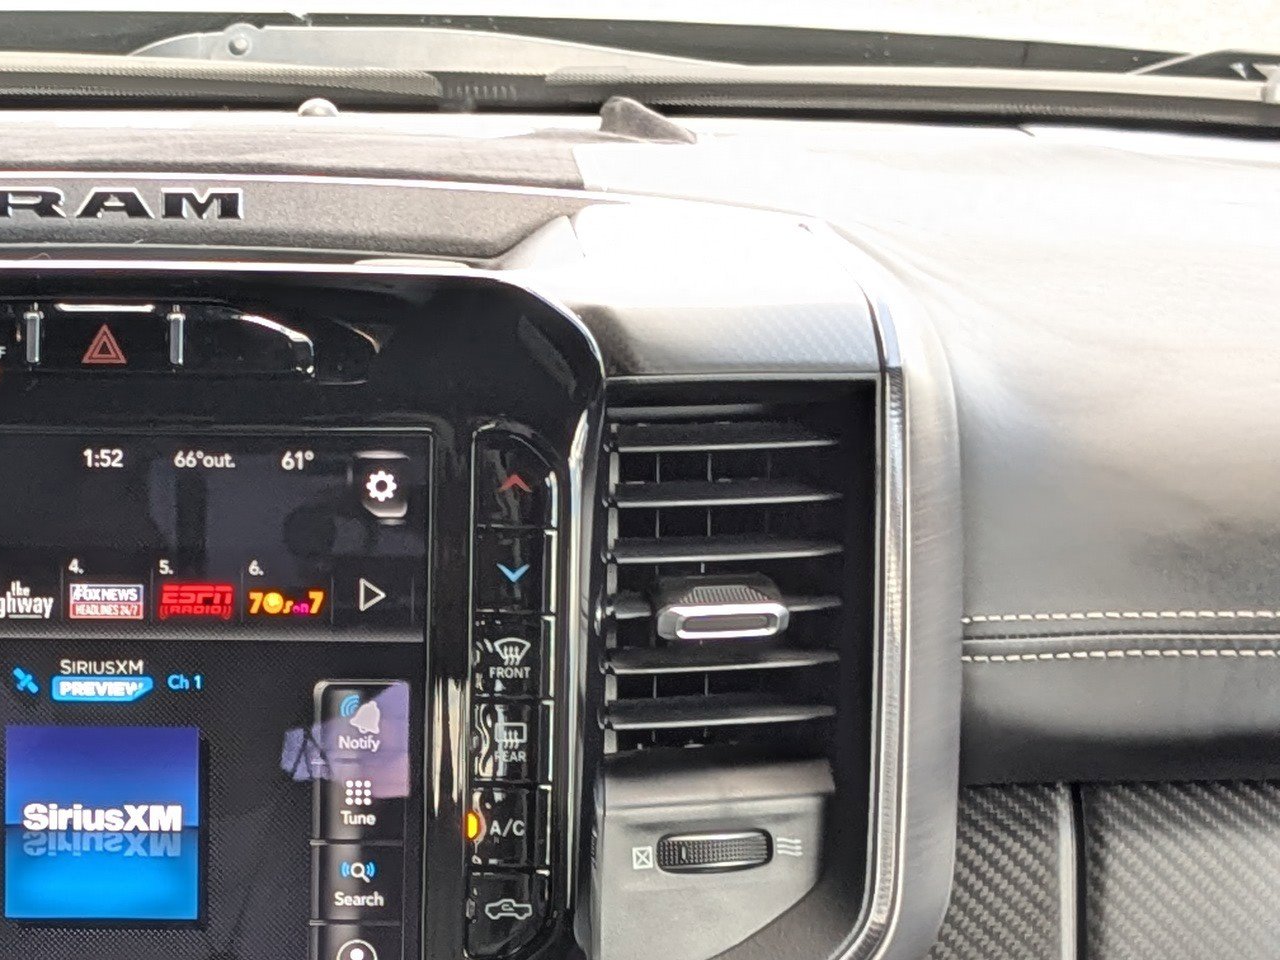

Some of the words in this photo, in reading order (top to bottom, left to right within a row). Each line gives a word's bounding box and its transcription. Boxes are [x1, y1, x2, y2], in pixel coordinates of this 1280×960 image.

[83, 449, 124, 467] 1:52
[281, 451, 315, 470] 61°
[68, 558, 84, 574] 4.
[159, 559, 174, 575] 5.
[249, 560, 264, 576] 6.
[11, 581, 30, 596] the
[161, 584, 233, 604] ESPN
[170, 604, 221, 615] RADIO
[60, 659, 144, 675] SIRIUSXM
[489, 667, 531, 679] FRONT
[59, 681, 144, 697] PREVIEW
[167, 674, 189, 690] Ch
[194, 675, 202, 690] 1
[338, 735, 380, 752] Notify
[493, 751, 527, 763] REAR
[23, 803, 182, 831] SiriusXM
[340, 811, 376, 826] Tune
[489, 819, 526, 837] A/C
[334, 892, 384, 907] Search
